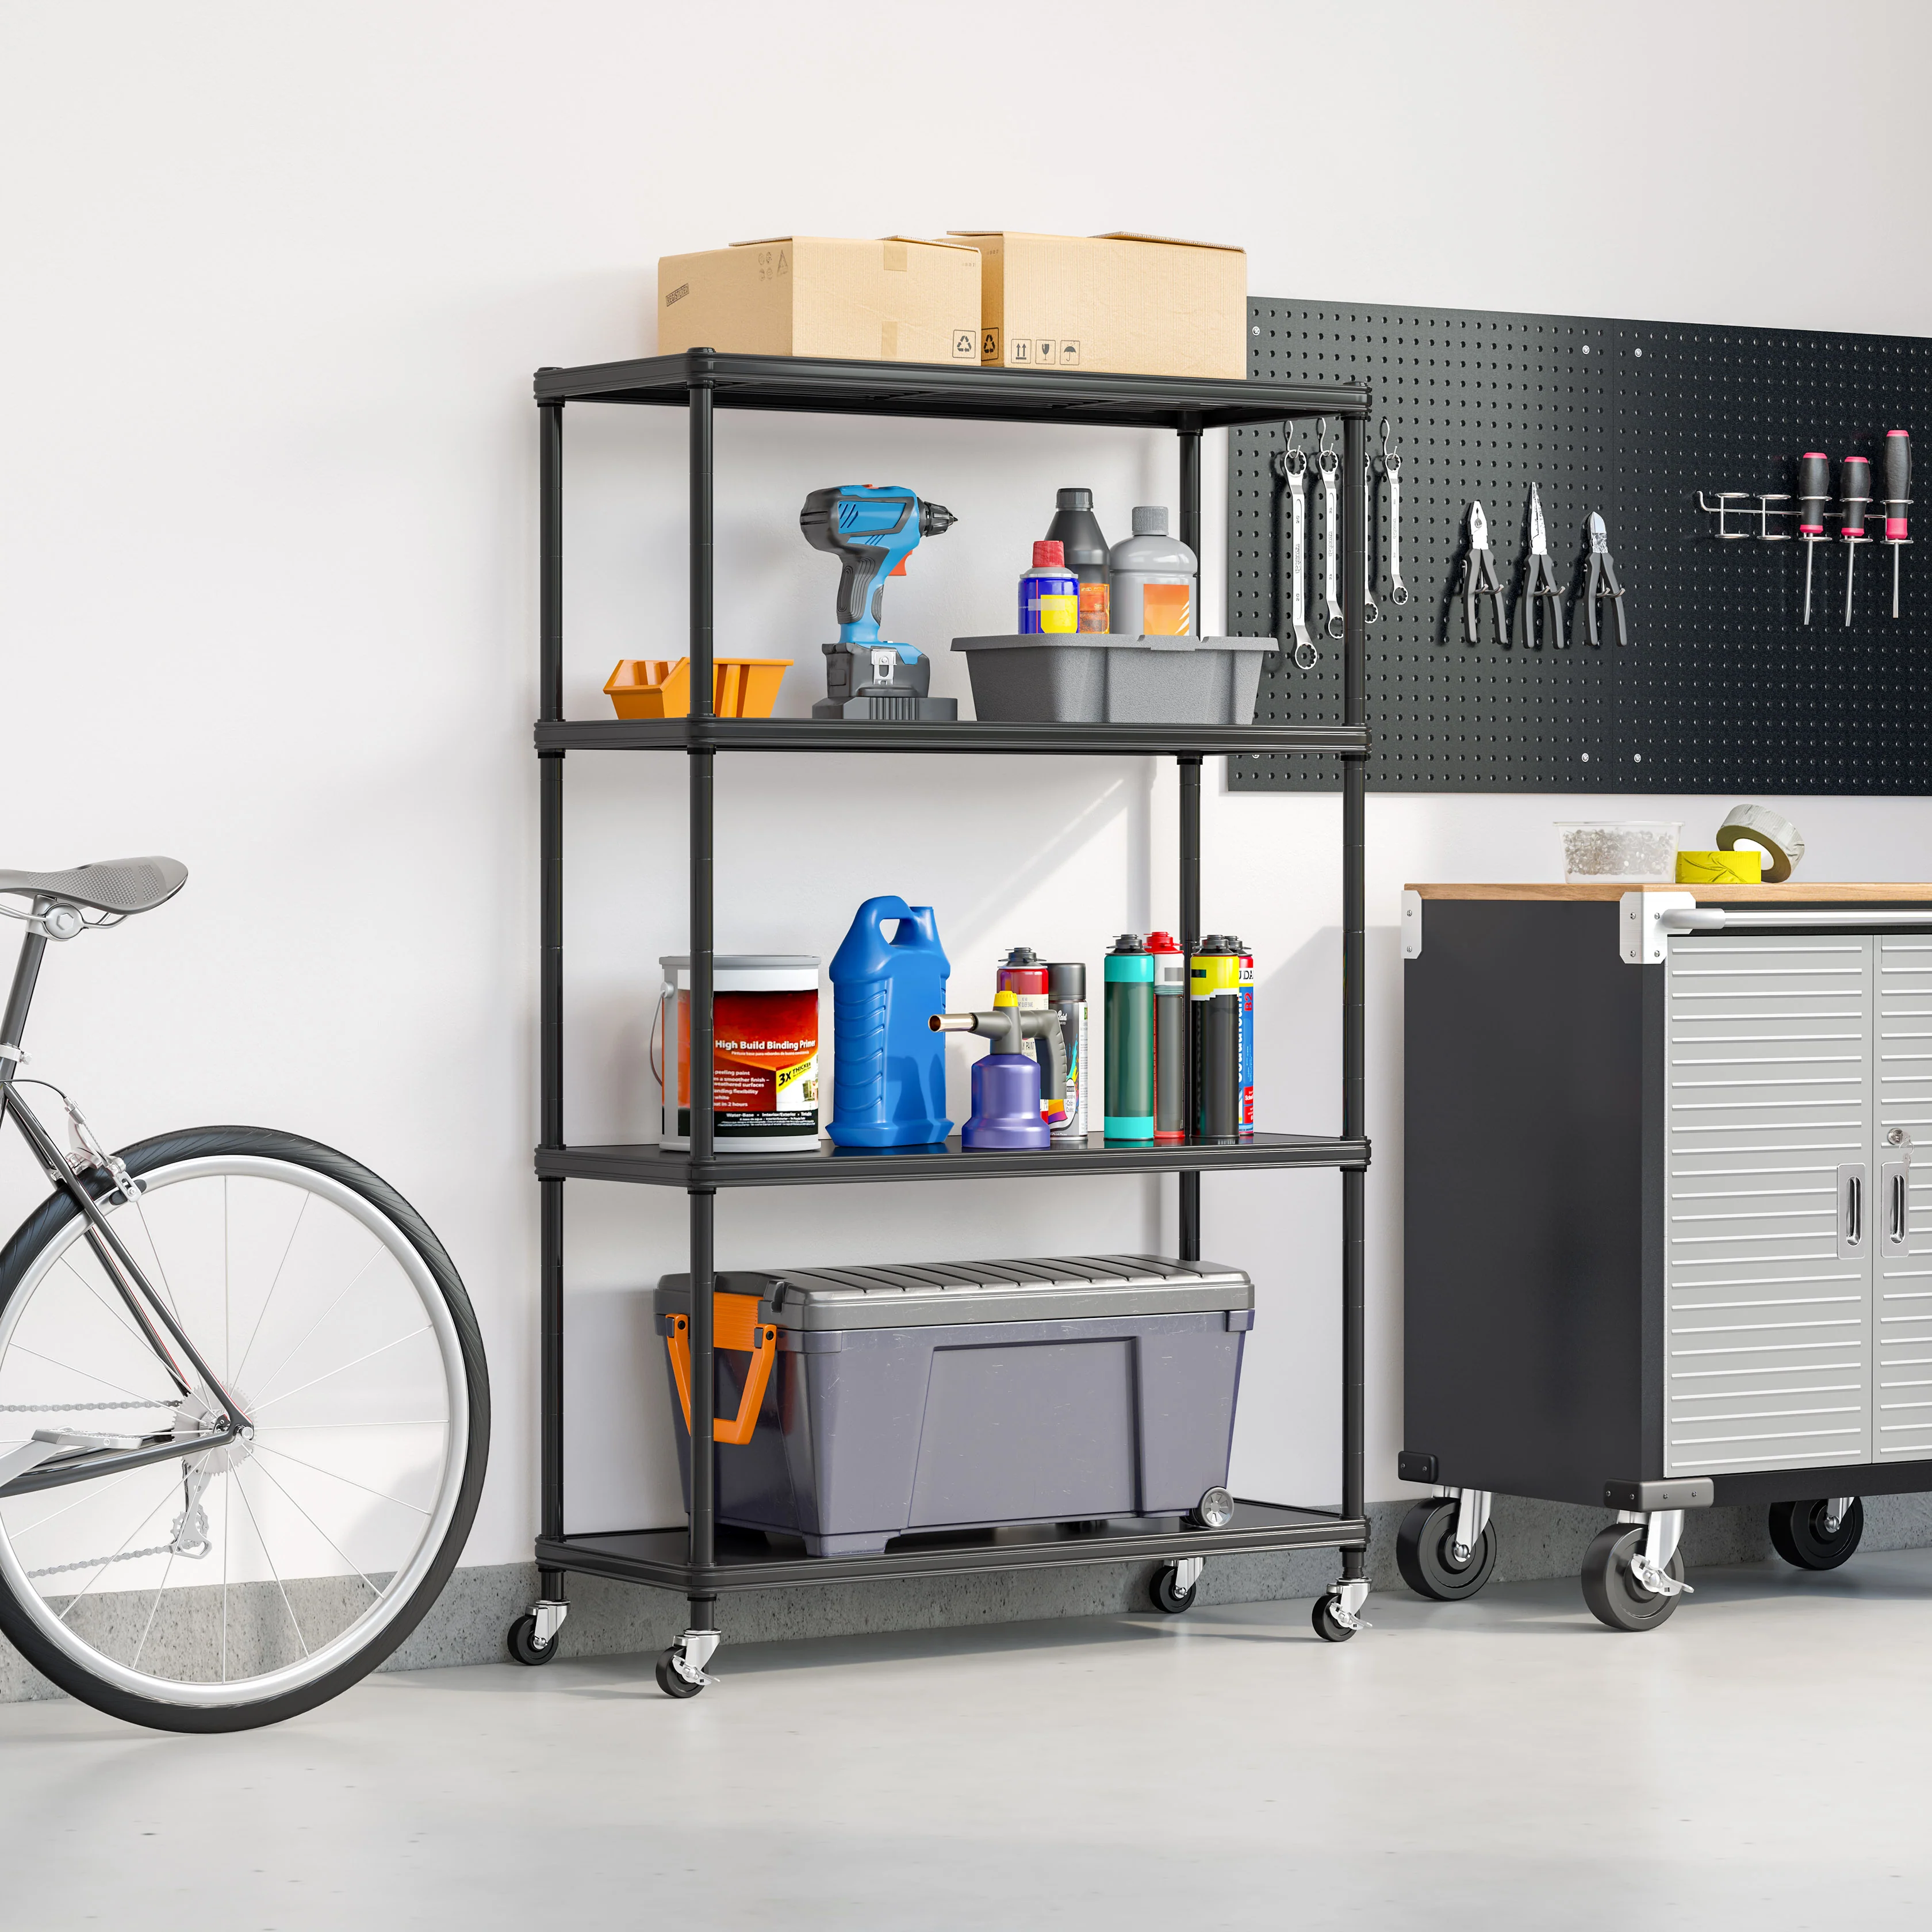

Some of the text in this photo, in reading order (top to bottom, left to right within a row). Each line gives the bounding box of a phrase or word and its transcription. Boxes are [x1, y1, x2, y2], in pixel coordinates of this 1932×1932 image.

[666, 286, 688, 305] REGISTERED
[1244, 992, 1252, 1011] B2
[715, 1040, 815, 1051] High Build Binding Primer
[792, 1062, 811, 1074] THICKER
